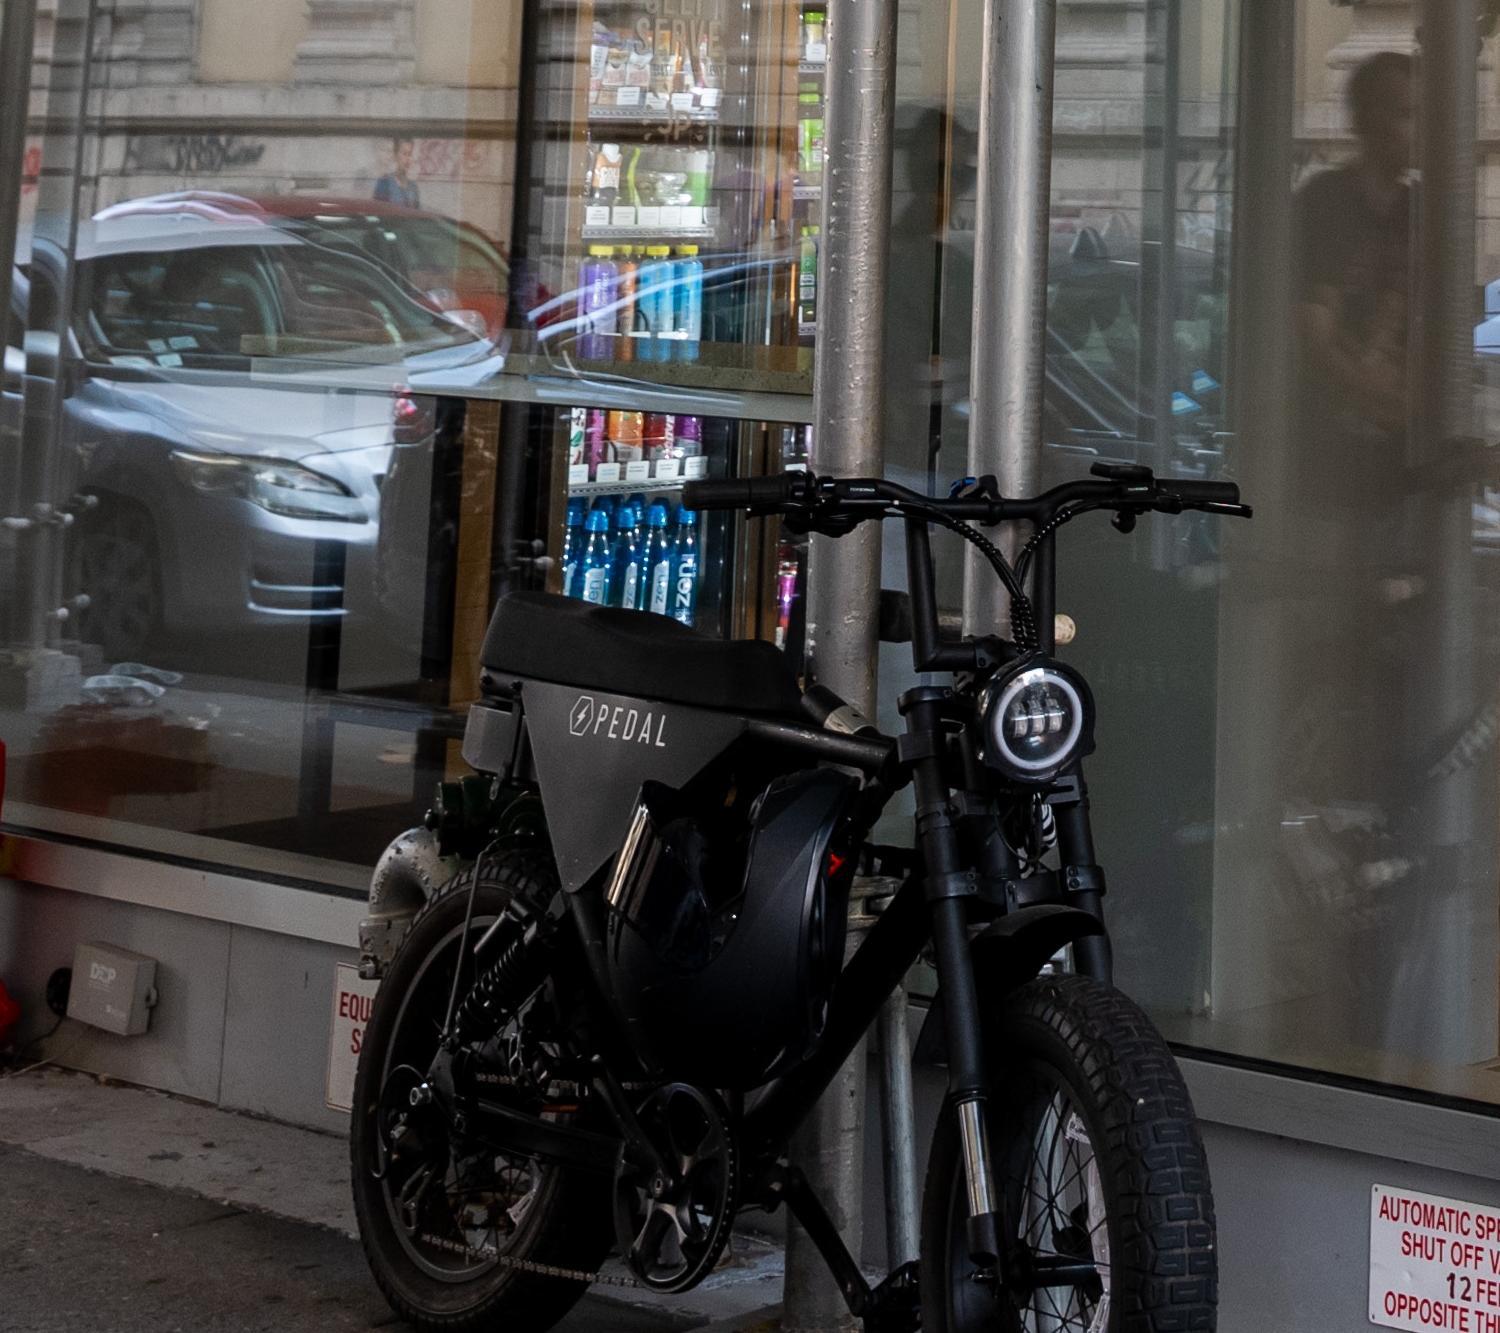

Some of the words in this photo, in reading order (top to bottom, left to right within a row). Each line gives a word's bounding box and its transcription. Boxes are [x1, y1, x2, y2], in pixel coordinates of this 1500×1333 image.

[634, 17, 723, 57] SERVE
[676, 562, 693, 607] zen
[593, 704, 666, 747] PEDAL
[1379, 1195, 1471, 1236] AUTOMATIC
[1401, 1232, 1446, 1263] SHUT
[1450, 1241, 1484, 1270] OFF
[1446, 1272, 1472, 1302] 12
[1384, 1290, 1470, 1333] OPPOSITE
